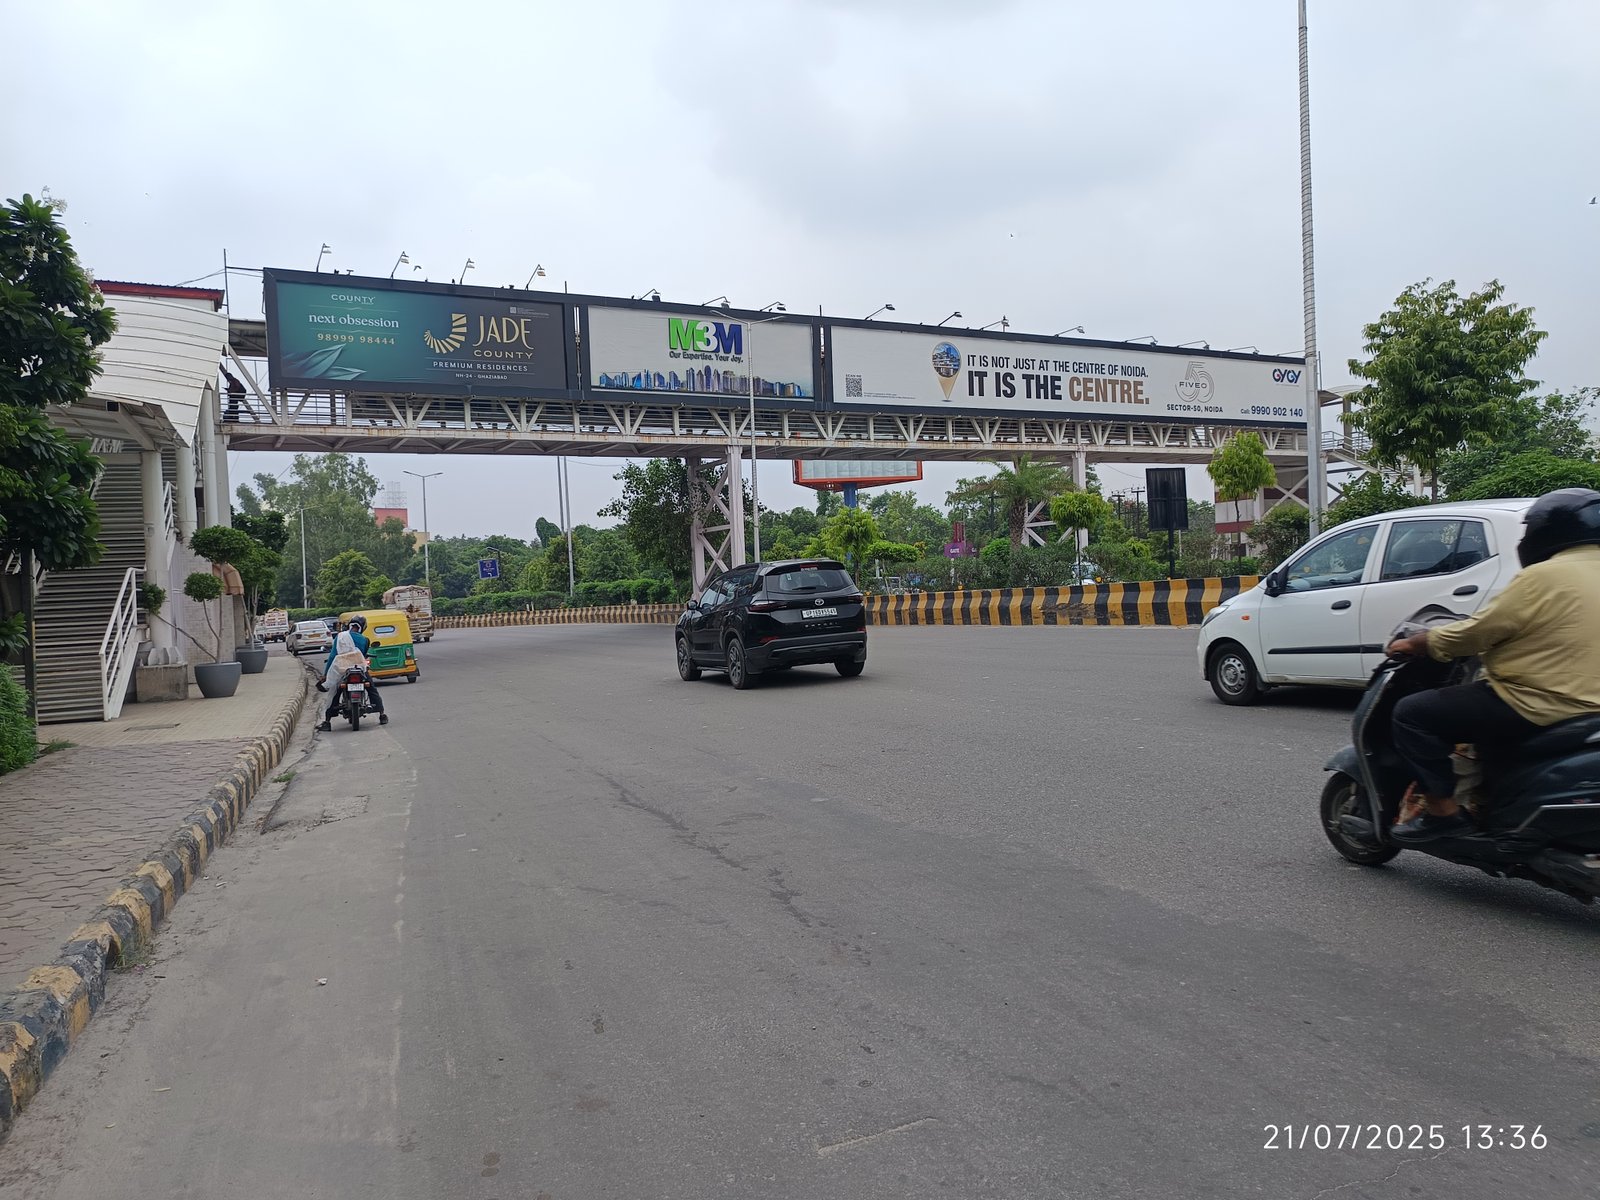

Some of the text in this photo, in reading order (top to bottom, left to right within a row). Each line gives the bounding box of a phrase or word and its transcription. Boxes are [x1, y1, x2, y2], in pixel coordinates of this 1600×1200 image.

[331, 294, 374, 303] COUNTY
[309, 314, 399, 328] next obsession
[472, 315, 535, 350] JADE
[668, 318, 743, 355] M3M
[317, 333, 395, 345] 98999 98444
[474, 349, 533, 360] COUNTY
[669, 351, 681, 359] Our
[682, 352, 714, 361] Expertise.
[715, 353, 730, 362] Your
[433, 361, 528, 372] PREMIUM RESIDENCES
[967, 354, 1149, 378] IT IS NOT JUST AT THE CENTRE OF NOIDA.
[967, 370, 1150, 405] IT IS THE CENTRE.
[1204, 405, 1224, 413] NOIDA
[1251, 405, 1271, 415] 9990
[1272, 406, 1288, 417] 902
[1289, 407, 1303, 417] 140
